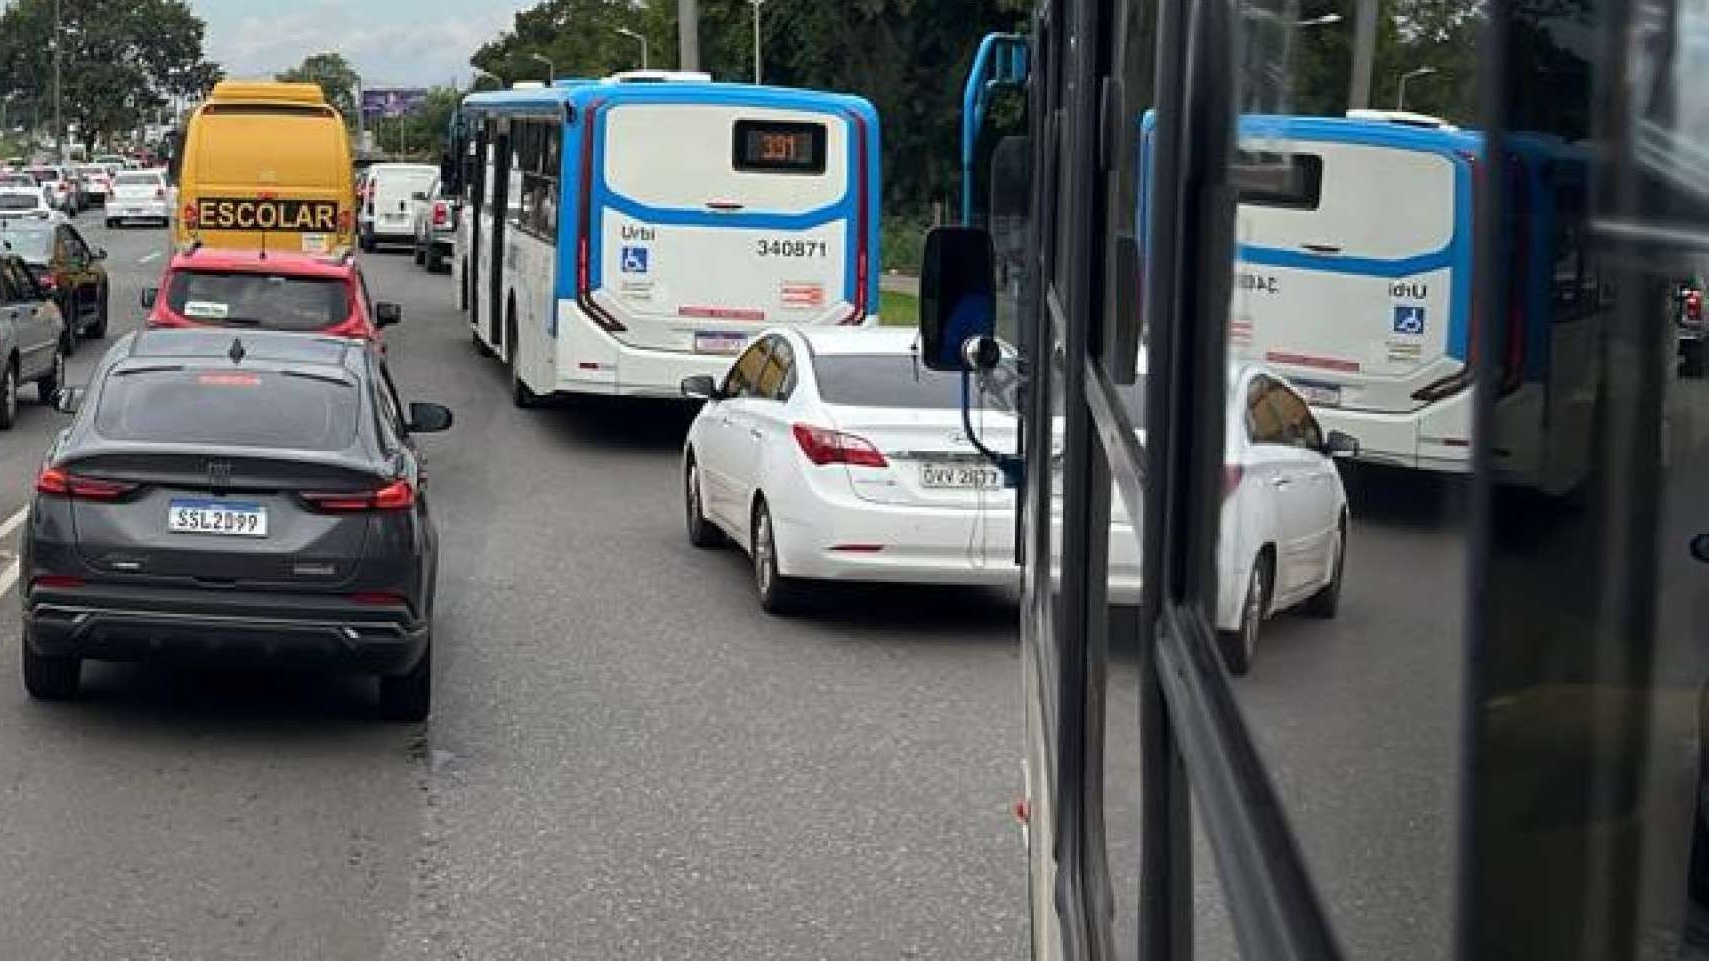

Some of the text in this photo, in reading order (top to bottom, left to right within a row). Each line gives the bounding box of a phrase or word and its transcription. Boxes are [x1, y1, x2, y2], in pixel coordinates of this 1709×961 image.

[200, 201, 333, 228] ESCOLAR
[621, 225, 655, 240] Urbi
[757, 240, 826, 257] 340871
